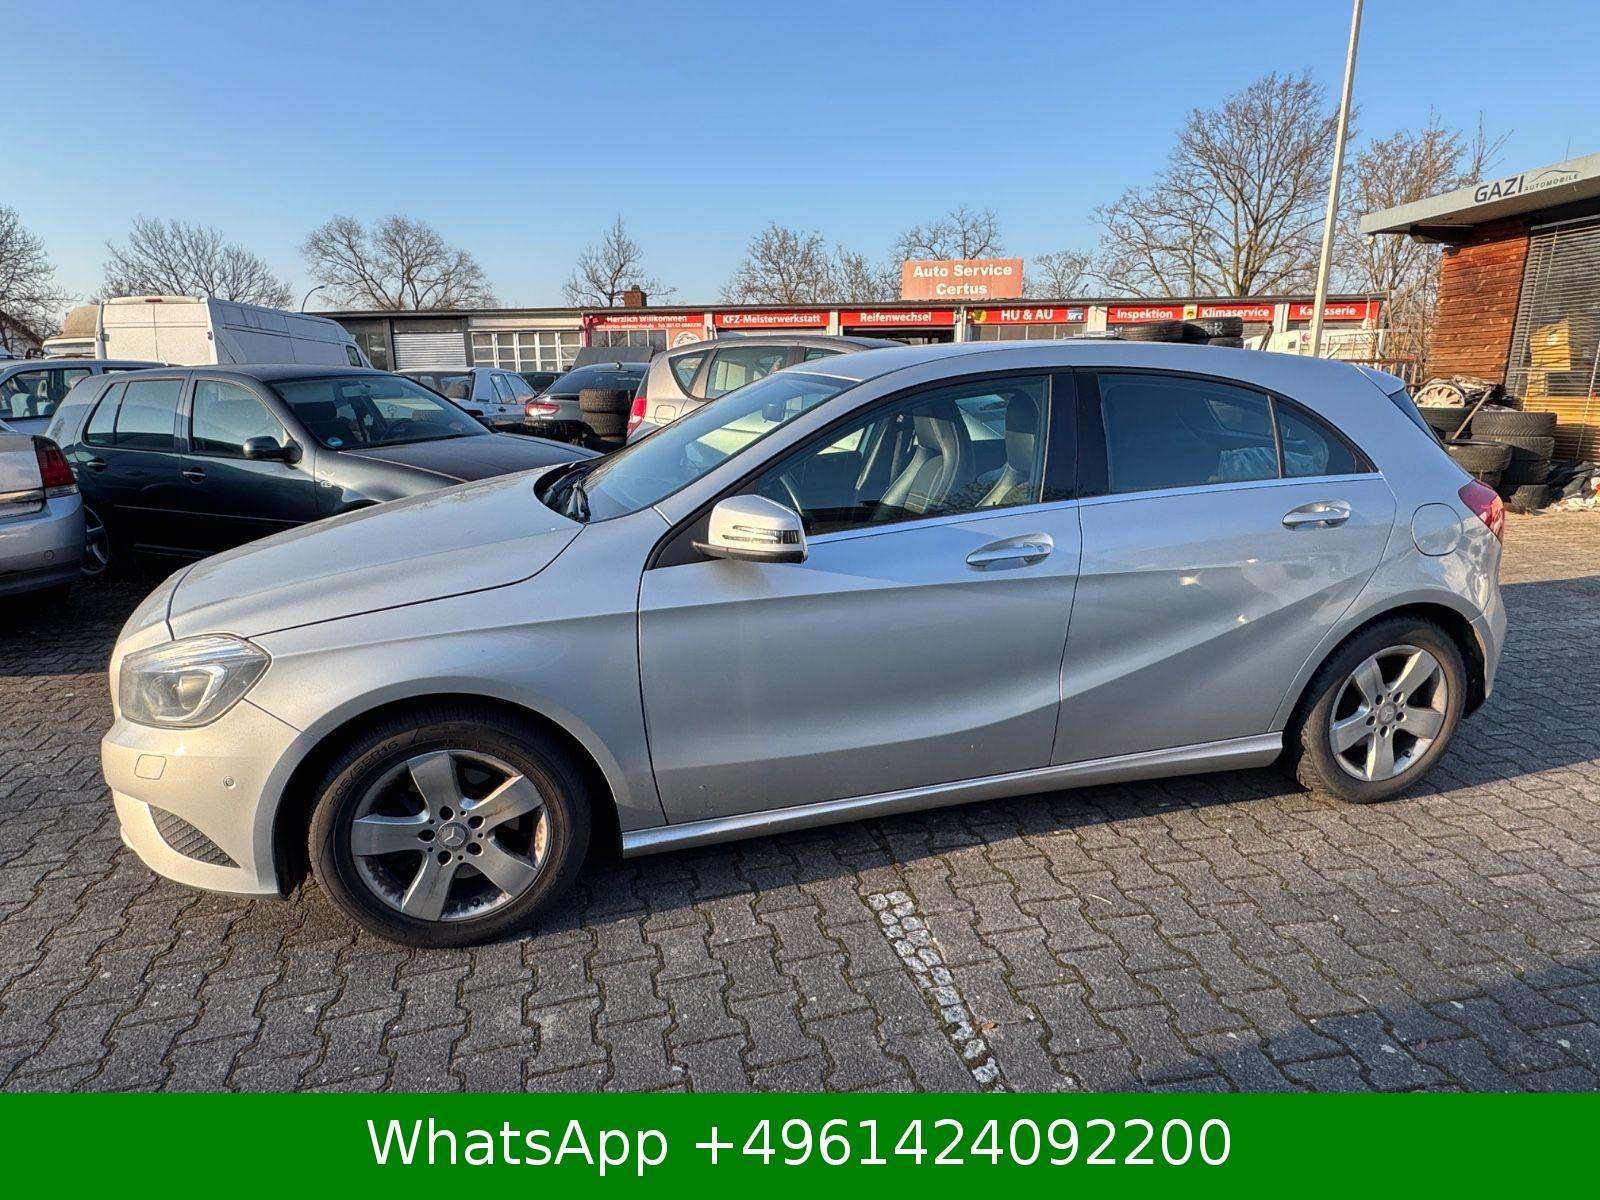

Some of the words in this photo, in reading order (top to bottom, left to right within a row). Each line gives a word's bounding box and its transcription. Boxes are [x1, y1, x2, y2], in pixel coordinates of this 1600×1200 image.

[1474, 175, 1525, 203] GAZI
[1524, 174, 1578, 191] AUTOMOBILE
[912, 265, 949, 278] Auto
[953, 264, 1013, 277] Service
[936, 283, 988, 295] Certus
[1001, 309, 1020, 320] HU
[1023, 309, 1032, 320] &
[1034, 309, 1054, 320] AU
[1116, 309, 1173, 321] Inspektion
[1201, 307, 1270, 318] Klimaservice
[1299, 306, 1356, 316] Kasserie
[606, 315, 638, 323] Herzlich
[639, 315, 688, 323] Willkommen
[722, 315, 821, 324] KFZ-Meisterwerkstatt
[860, 312, 932, 322] Reifenwechsel
